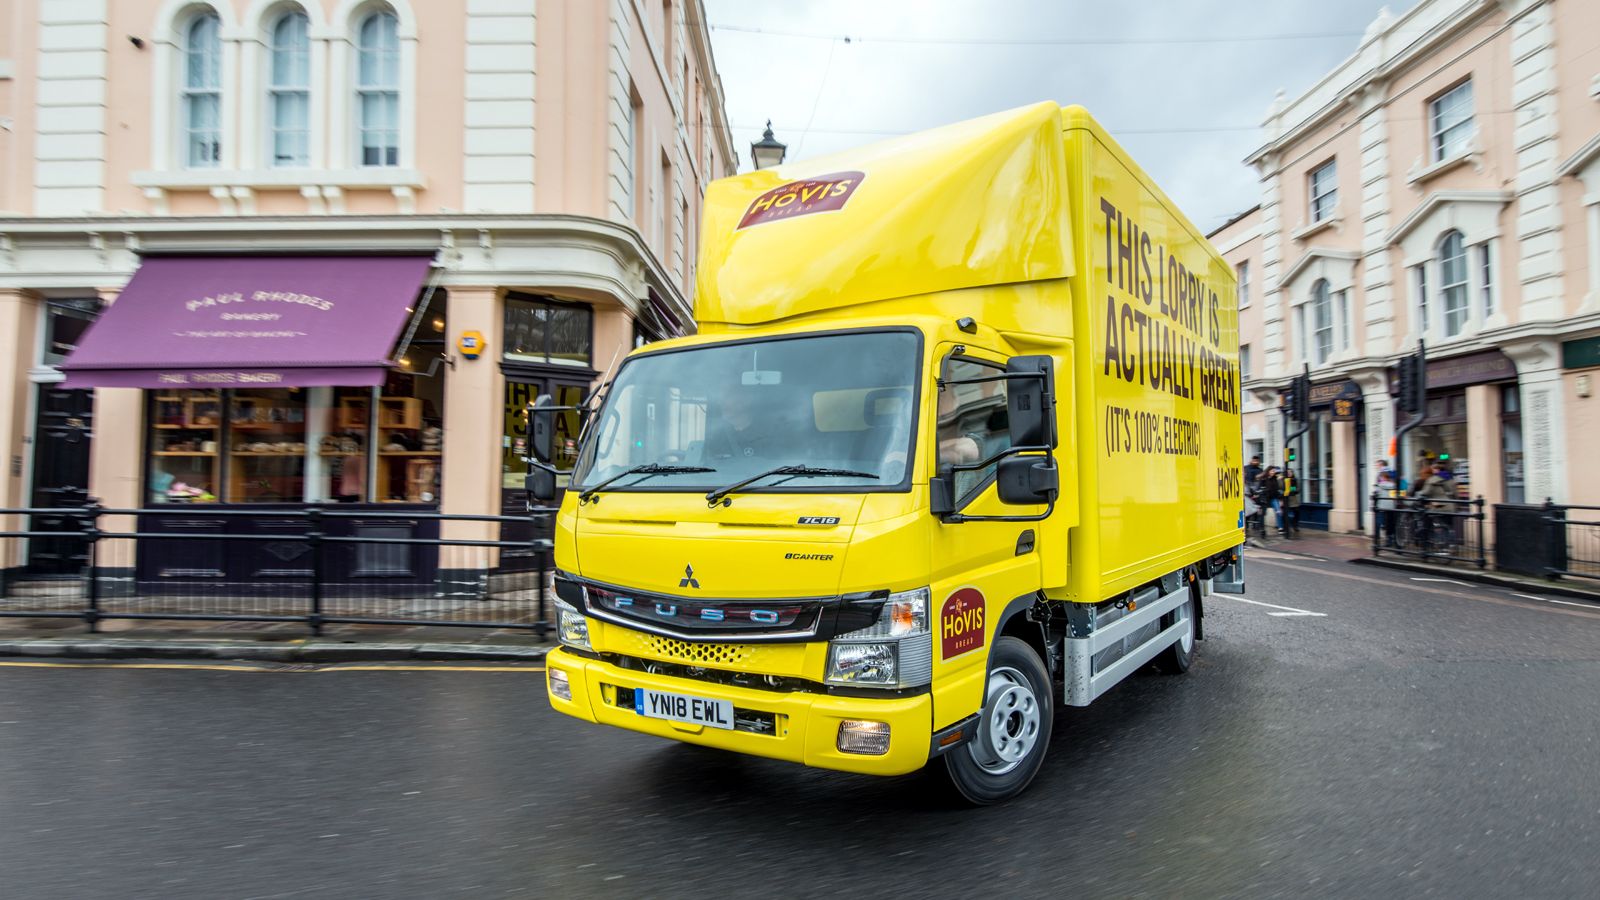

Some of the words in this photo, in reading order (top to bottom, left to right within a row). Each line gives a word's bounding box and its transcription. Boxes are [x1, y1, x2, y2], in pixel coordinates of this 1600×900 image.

[750, 180, 852, 214] HOVIS
[1100, 196, 1153, 305] THIS
[1159, 245, 1205, 337] LORRY
[1208, 288, 1219, 347] IS
[185, 292, 245, 311] PAUL
[251, 290, 335, 311] RHODES
[1104, 295, 1195, 400] ACTUALLY
[1200, 345, 1238, 415] GREEN.
[1134, 410, 1163, 454] 100%
[1164, 416, 1201, 460] ELECTRIC)
[1217, 467, 1240, 501] HOVIS
[615, 597, 779, 624] FUSO
[944, 606, 983, 639] HOVIS
[649, 693, 687, 717] YN18
[692, 699, 727, 724] EWL
